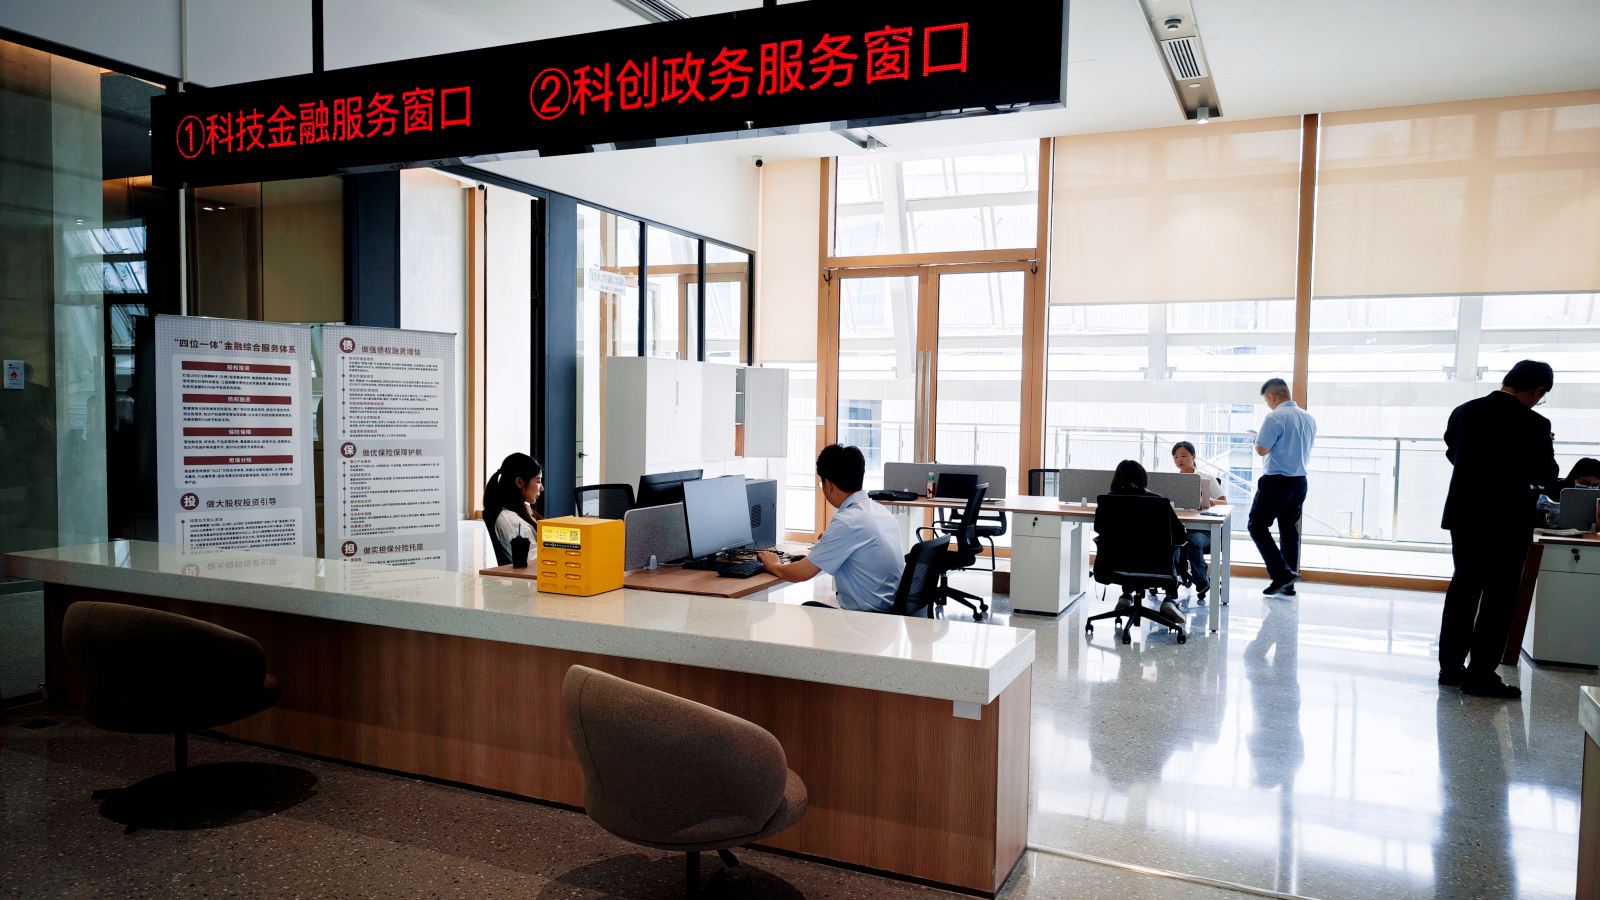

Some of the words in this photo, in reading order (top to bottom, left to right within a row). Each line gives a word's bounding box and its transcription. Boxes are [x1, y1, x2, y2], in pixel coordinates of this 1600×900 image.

[529, 22, 970, 121] ②科创政务服务窗口
[176, 85, 473, 159] ①科技金融服务窗口
[362, 448, 423, 457] 做优保险保障护航
[183, 496, 196, 507] 投
[206, 497, 277, 508] 做大股权投资引导
